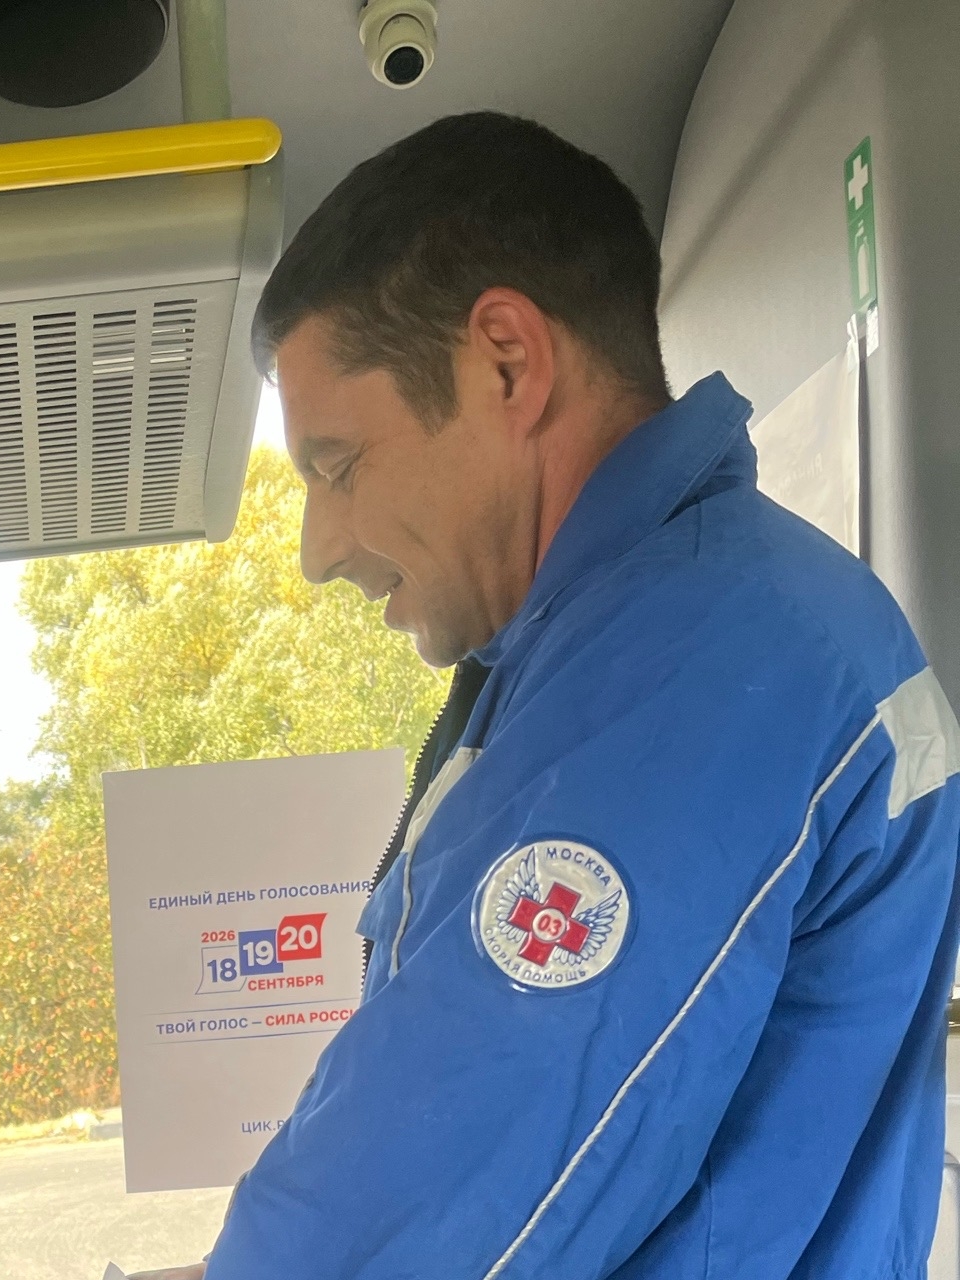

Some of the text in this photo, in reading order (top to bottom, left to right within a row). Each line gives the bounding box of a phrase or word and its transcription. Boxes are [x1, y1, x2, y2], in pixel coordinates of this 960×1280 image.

[546, 847, 611, 887] МОСКВА
[149, 880, 370, 910] ЕДИНЫЙ ДЕНЬ ГОЛОСОВАНИЯ
[201, 930, 236, 943] 2026
[537, 914, 563, 937] 03
[207, 924, 319, 983] 18 19 20
[484, 927, 586, 983] СКОРАЯ ПОМОЩЬ
[247, 974, 324, 991] СЕНТЯБРЯ
[156, 1019, 196, 1035] ТВОЙ
[200, 1017, 249, 1032] ГОЛОС
[265, 1013, 306, 1027] СИЛА
[309, 1009, 353, 1023] РОСС
